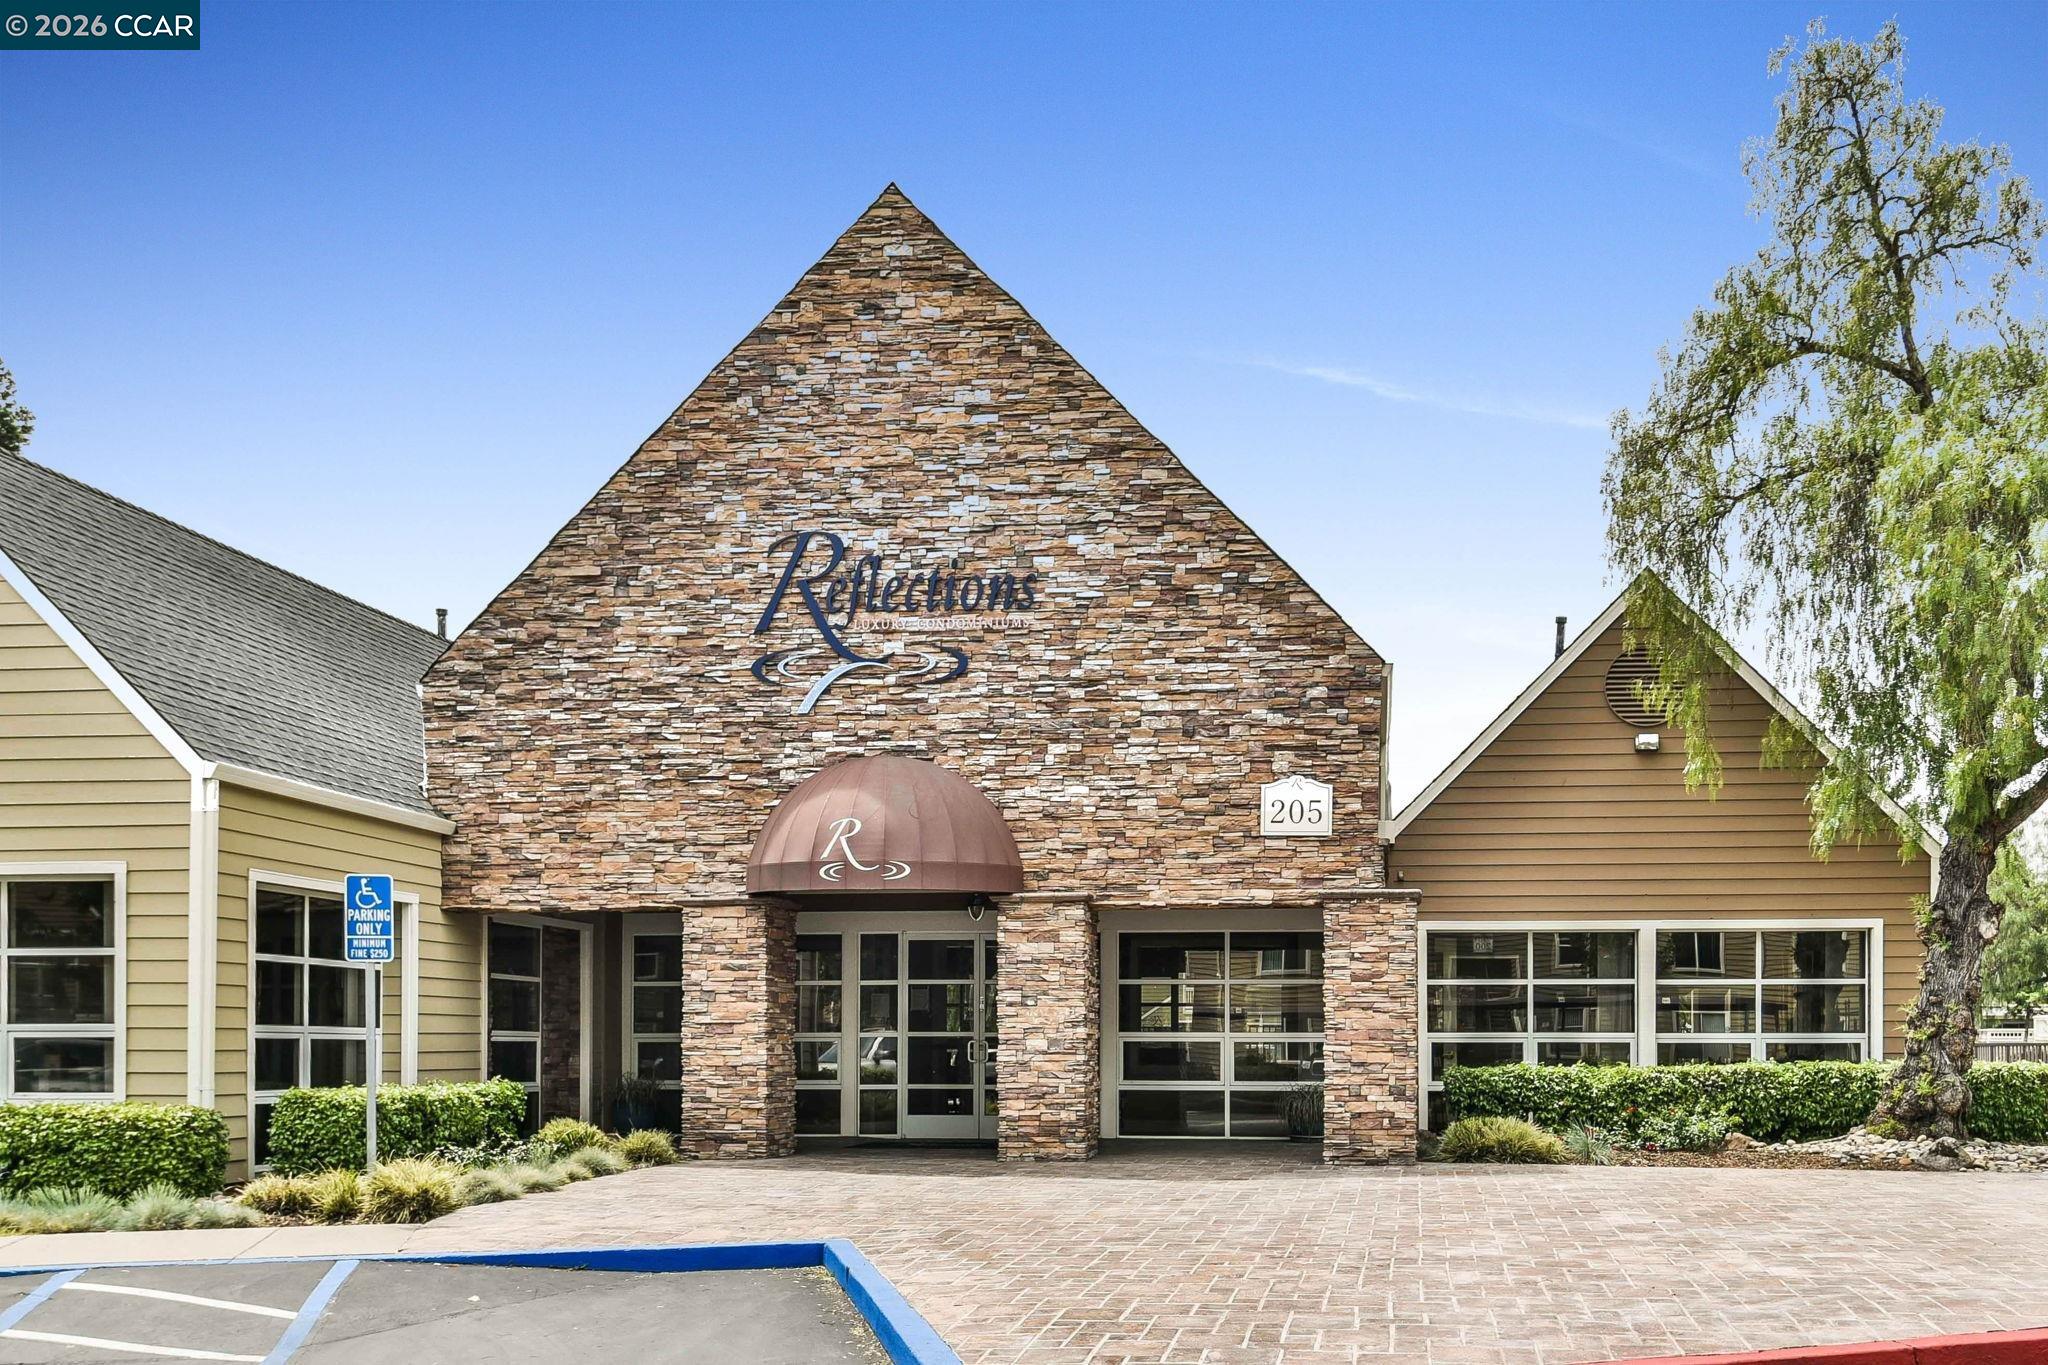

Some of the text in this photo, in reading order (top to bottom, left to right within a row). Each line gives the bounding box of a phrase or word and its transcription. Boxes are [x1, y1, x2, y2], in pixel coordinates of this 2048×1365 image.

[754, 530, 1038, 664] Reflections
[854, 617, 1030, 630] LUXURY CONDOMINIUMS
[1270, 799, 1323, 824] 205
[348, 909, 391, 921] PARKING
[356, 923, 383, 935] ONLY
[353, 939, 386, 948] MINIMUM
[350, 948, 389, 958] FINE $250
